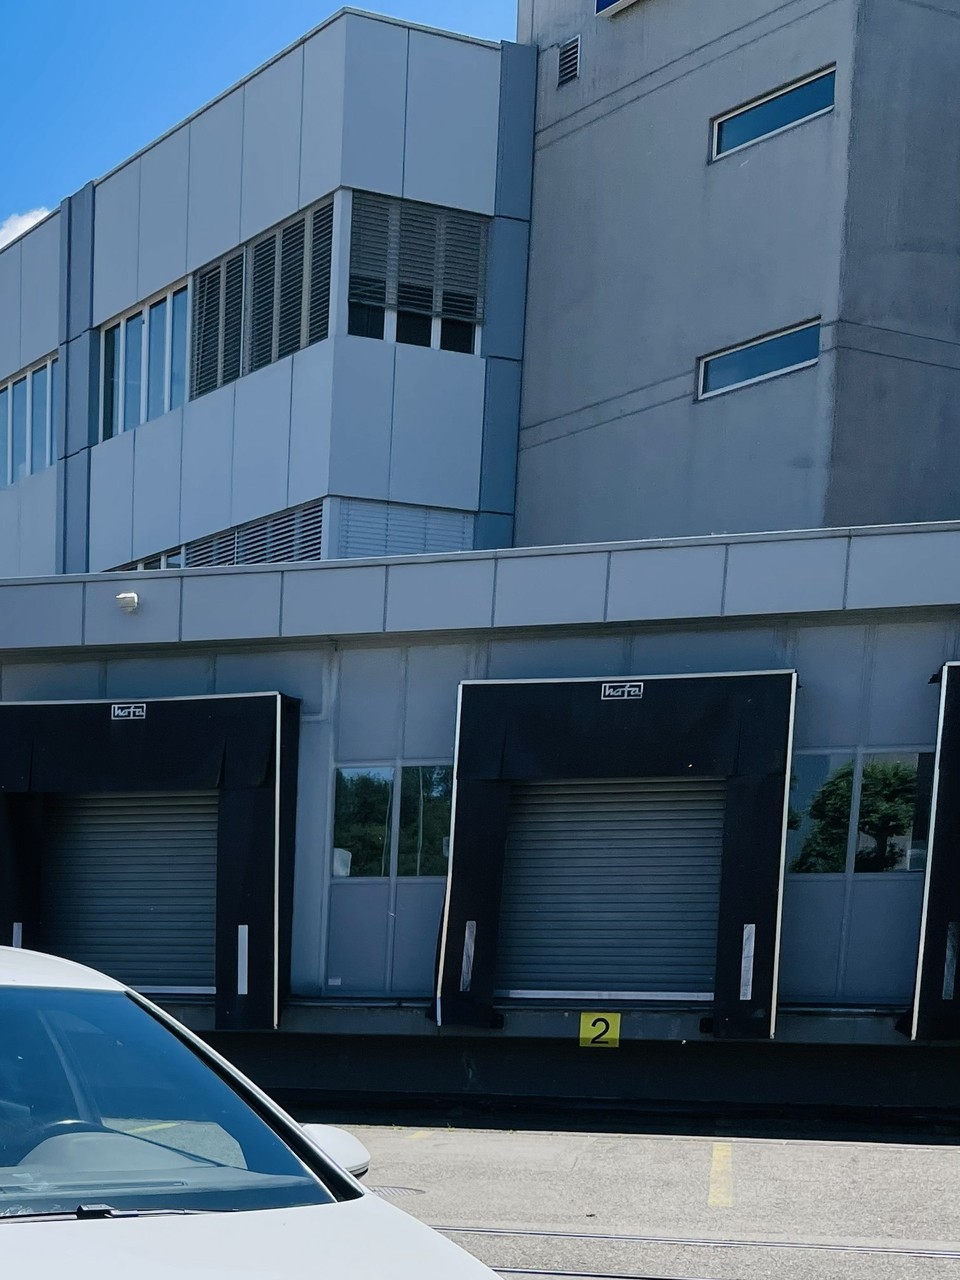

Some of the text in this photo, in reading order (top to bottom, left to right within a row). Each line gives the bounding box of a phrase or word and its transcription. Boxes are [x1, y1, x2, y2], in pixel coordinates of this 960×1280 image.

[603, 683, 642, 699] hafa
[113, 704, 145, 719] hafa
[590, 1017, 610, 1045] 2
